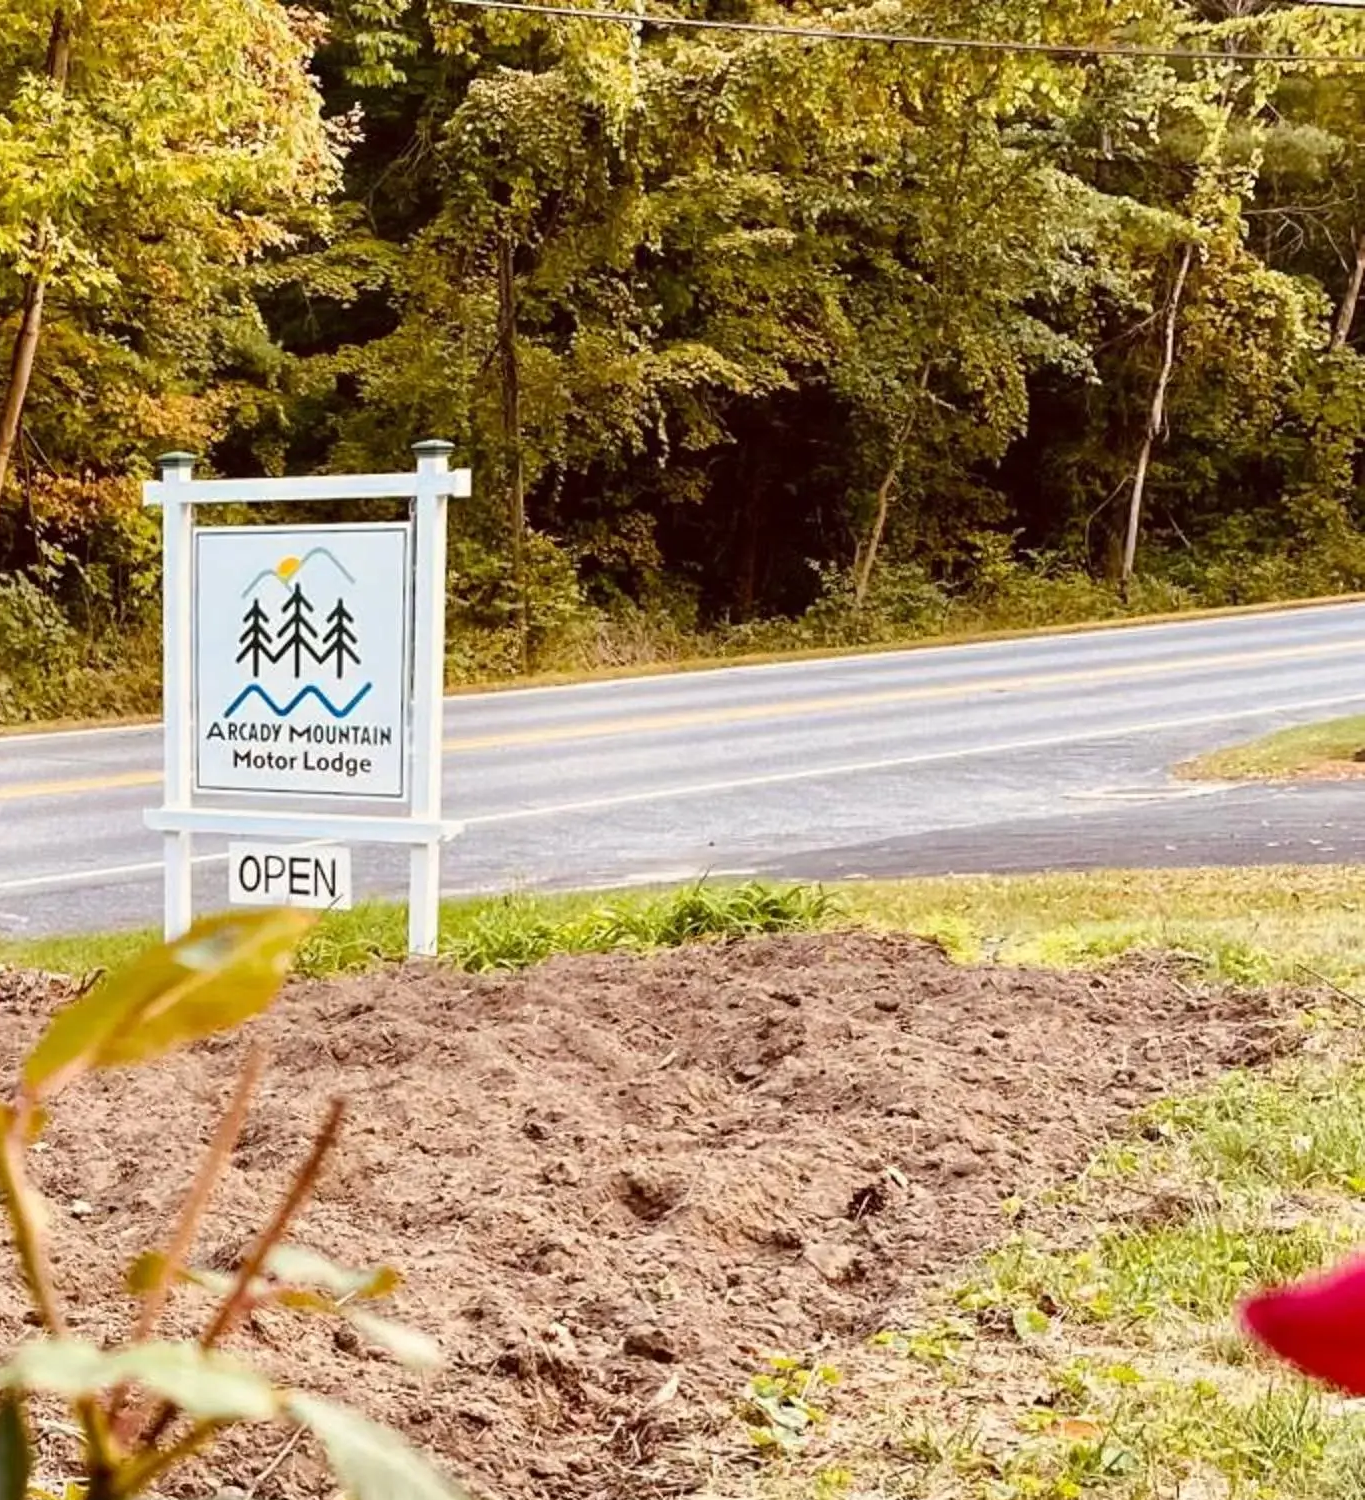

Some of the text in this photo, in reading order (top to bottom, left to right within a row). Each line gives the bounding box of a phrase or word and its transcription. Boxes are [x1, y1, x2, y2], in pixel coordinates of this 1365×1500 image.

[206, 721, 392, 745] ARCADY MOUNTAIN
[233, 749, 372, 776] Motor Lodge
[238, 855, 336, 898] OPEN
